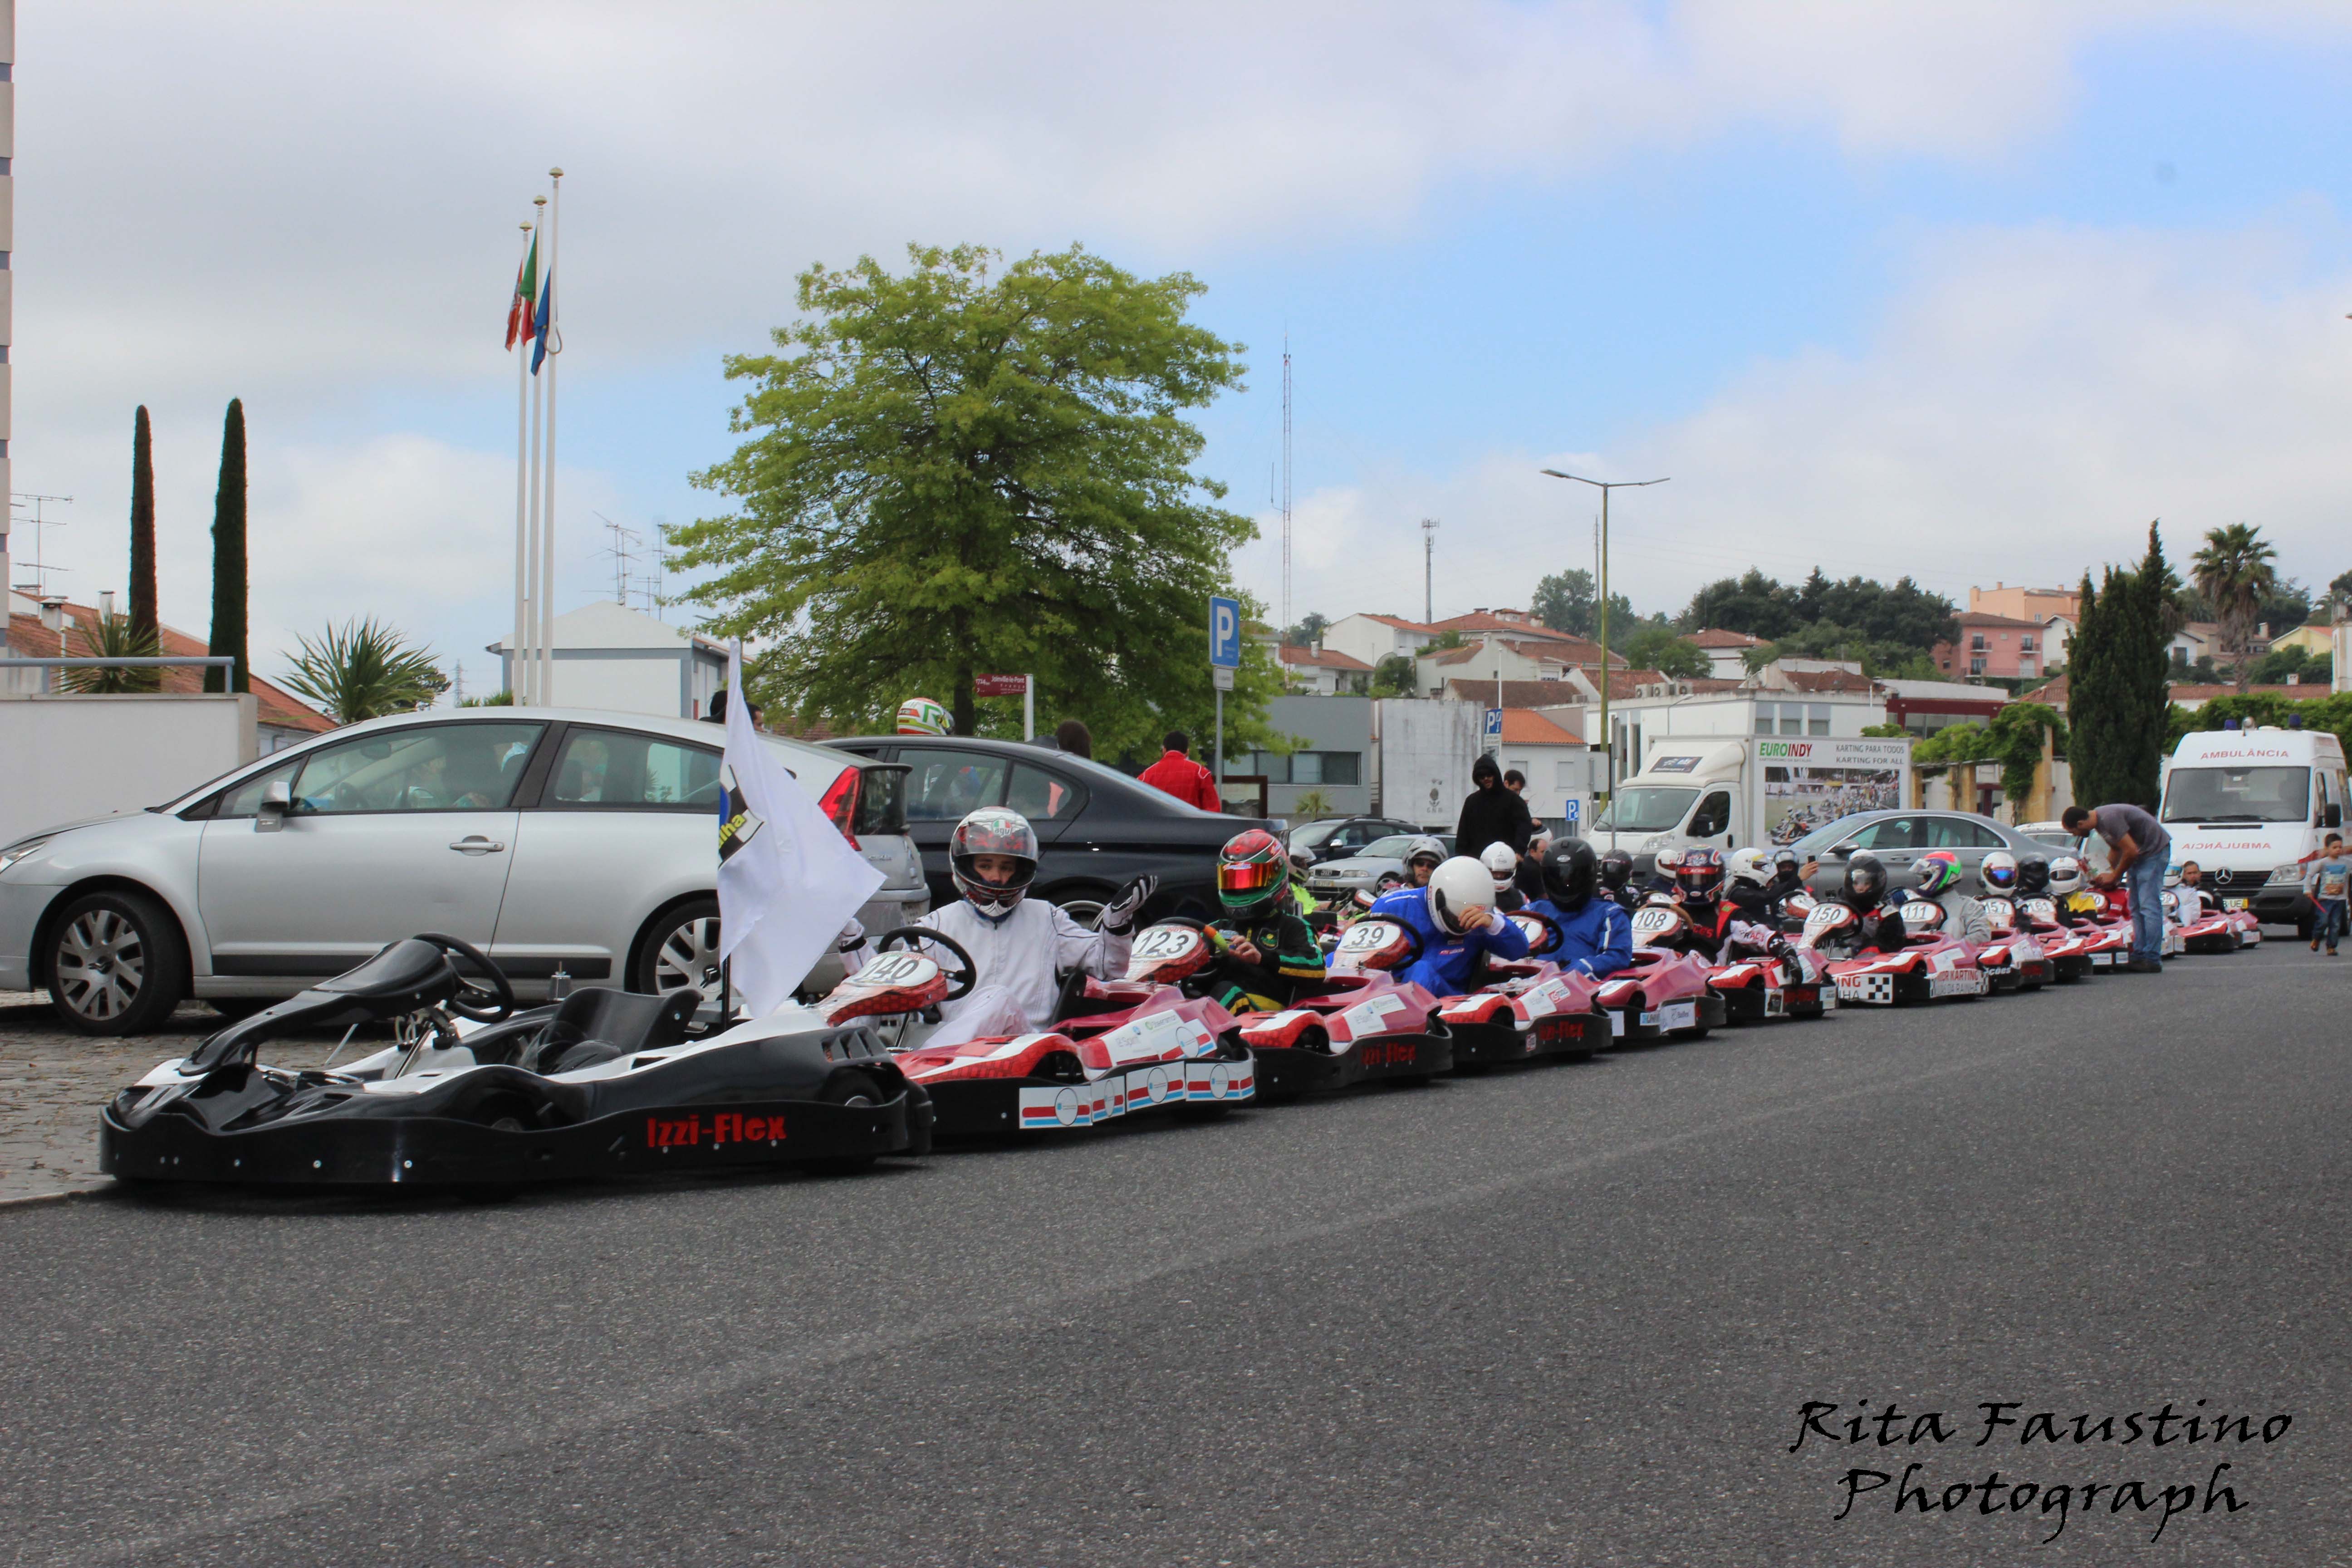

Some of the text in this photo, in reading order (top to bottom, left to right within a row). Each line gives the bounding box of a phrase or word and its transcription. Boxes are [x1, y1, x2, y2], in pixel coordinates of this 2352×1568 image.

[1217, 606, 1234, 657] P
[1759, 742, 1813, 757] EUROINDY
[1836, 744, 1905, 754] KARTING PARA TODOS
[2200, 748, 2289, 759] AMBULÂNCIA
[1635, 912, 1667, 929] 108
[1813, 907, 1841, 921] 150
[1137, 931, 1189, 954] 123
[1352, 927, 1384, 945] 39
[862, 956, 919, 979] 140
[647, 1113, 787, 1147] Izzi-Flex
